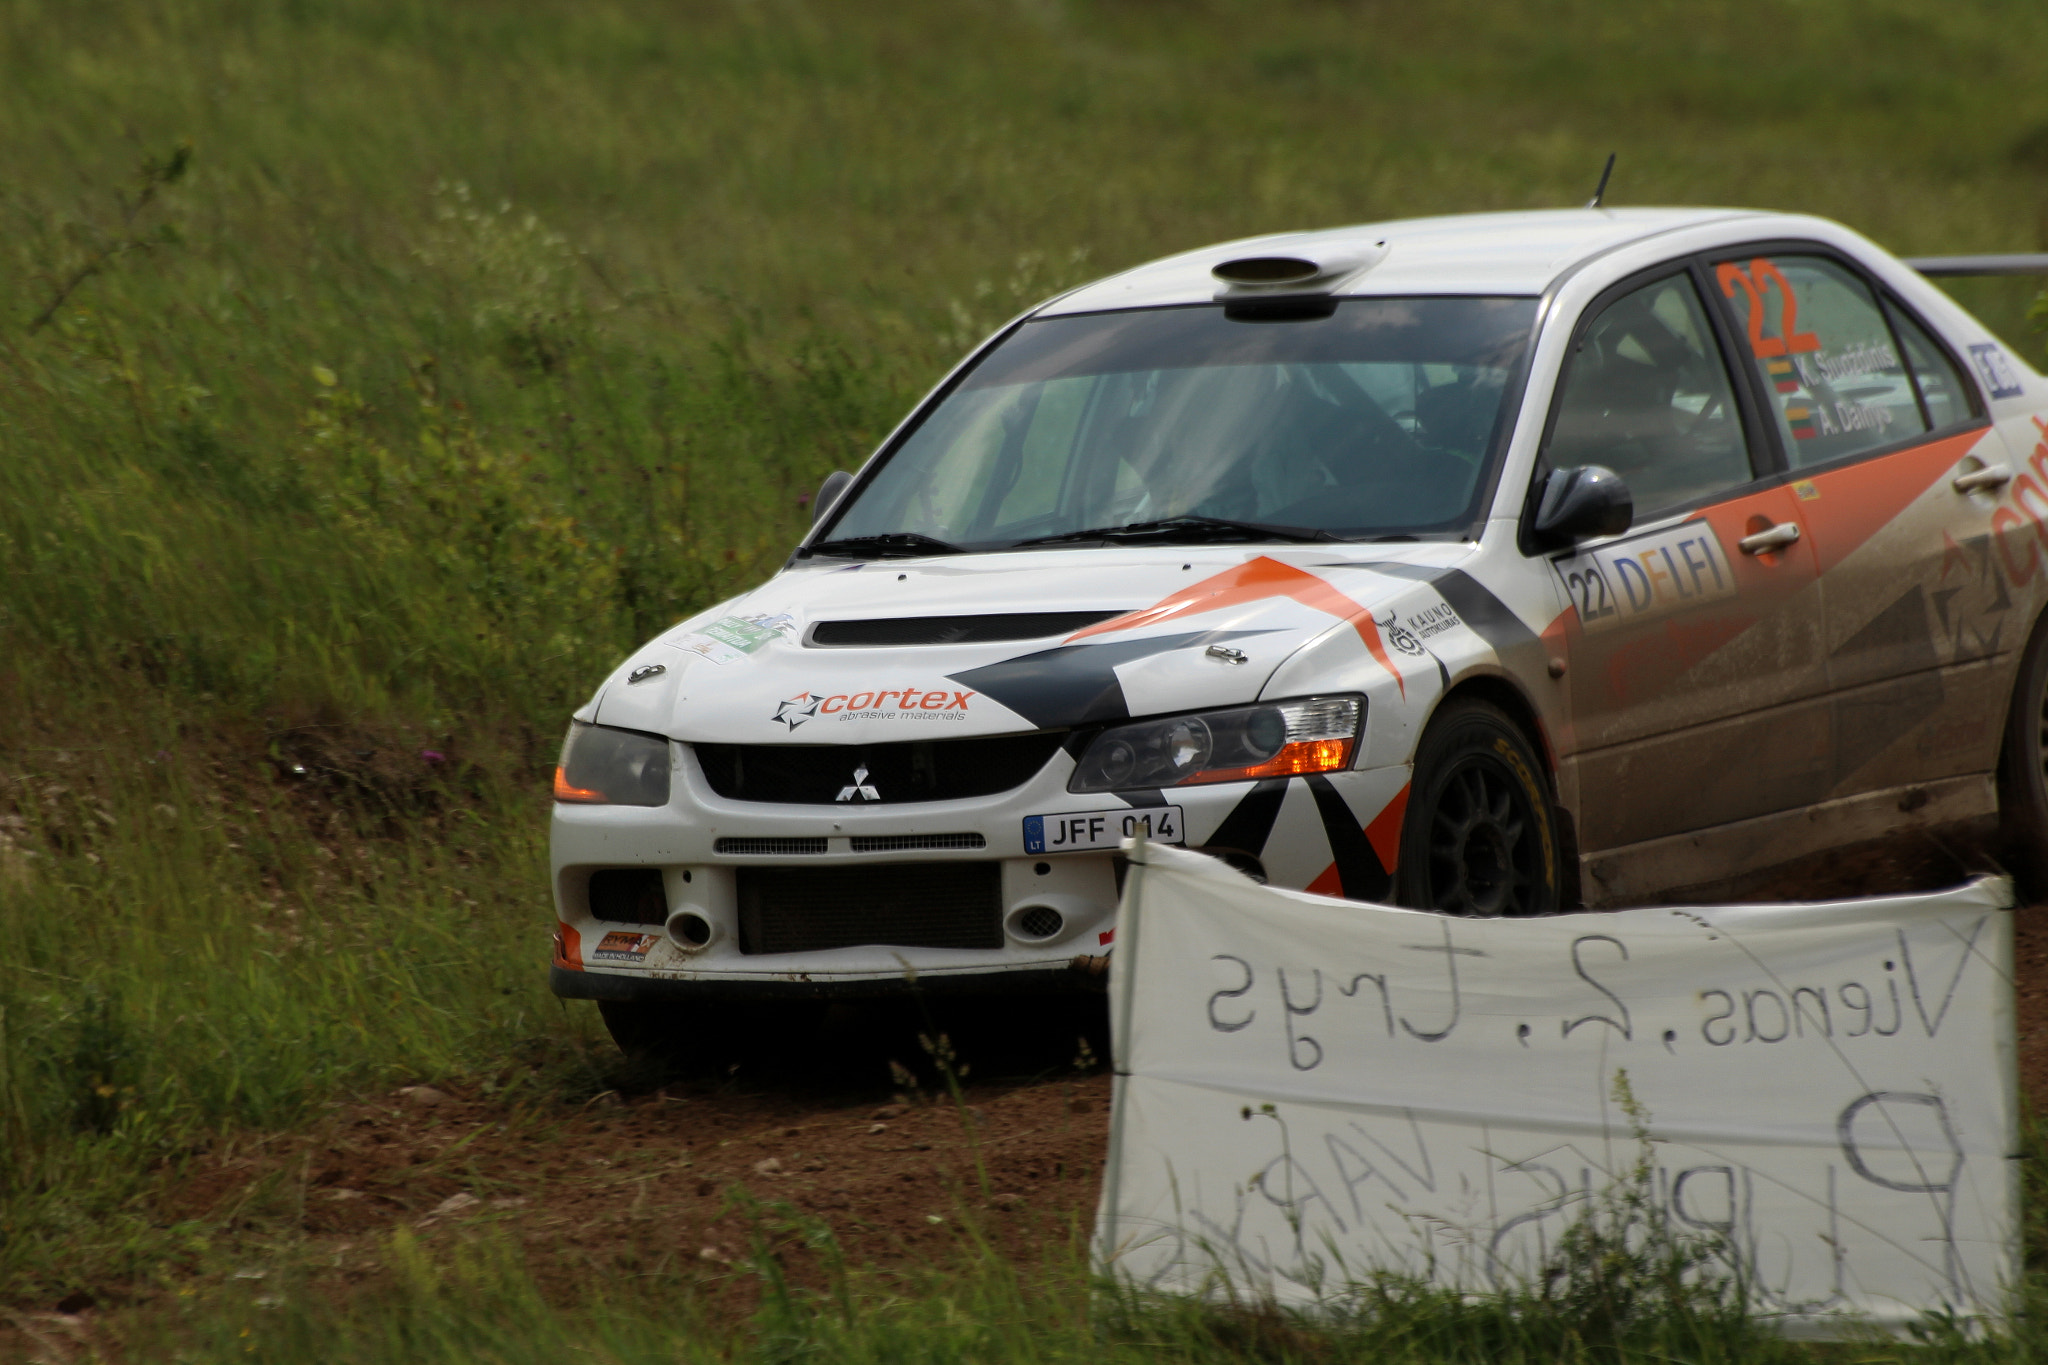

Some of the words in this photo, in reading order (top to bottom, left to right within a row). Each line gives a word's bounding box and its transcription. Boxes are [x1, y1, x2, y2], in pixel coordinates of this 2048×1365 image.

[1716, 257, 1822, 359] 22
[1818, 404, 1839, 436] A.
[1567, 563, 1616, 623] 22
[1613, 536, 1726, 614] DELFI
[1407, 602, 1453, 631] KAUNO
[820, 687, 977, 714] cortex
[839, 709, 896, 722] abrasive
[900, 709, 966, 721] materials
[1052, 817, 1105, 845] JFF
[1122, 812, 1174, 839] 014
[1030, 841, 1041, 850] LT
